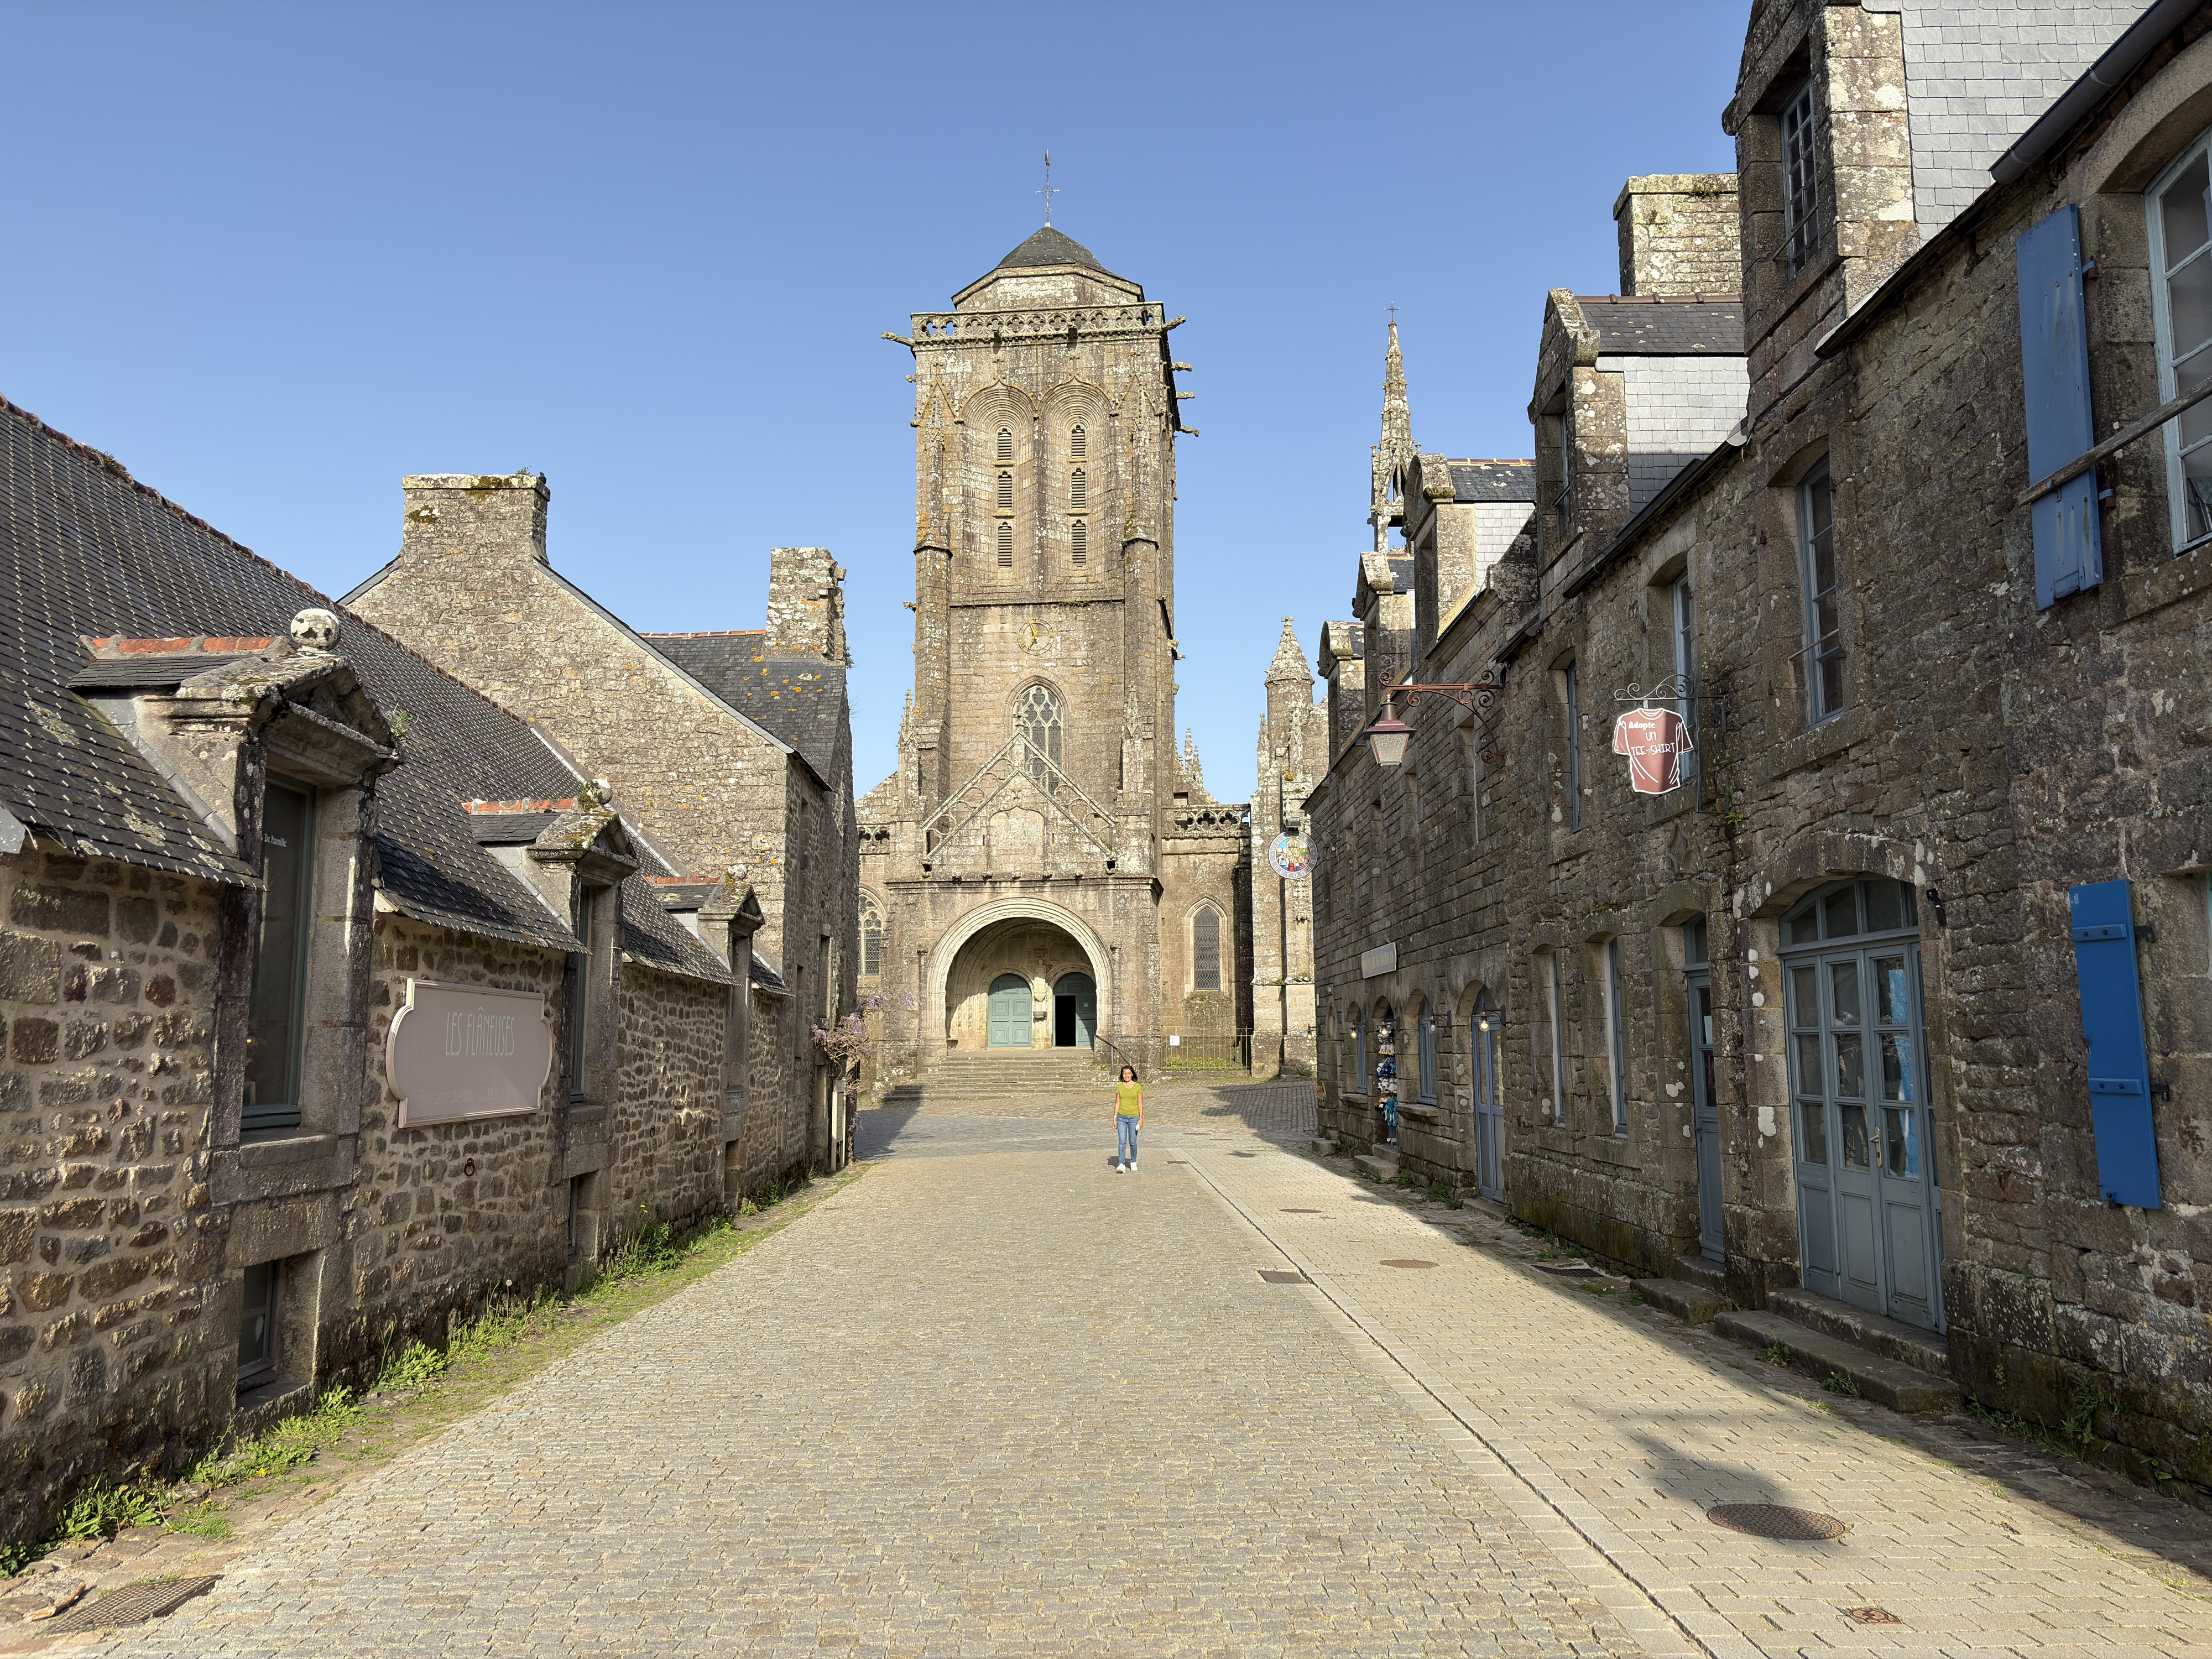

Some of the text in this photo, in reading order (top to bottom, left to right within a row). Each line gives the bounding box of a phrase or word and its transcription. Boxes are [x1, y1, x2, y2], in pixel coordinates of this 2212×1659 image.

[1628, 721, 1656, 731] Adopte
[1645, 732, 1657, 742] UN
[1630, 742, 1676, 757] TEE-SHIRT
[264, 833, 286, 847] De Famille
[1271, 859, 1316, 878] locronan
[445, 1005, 515, 1056] LES FLÂNEUSES
